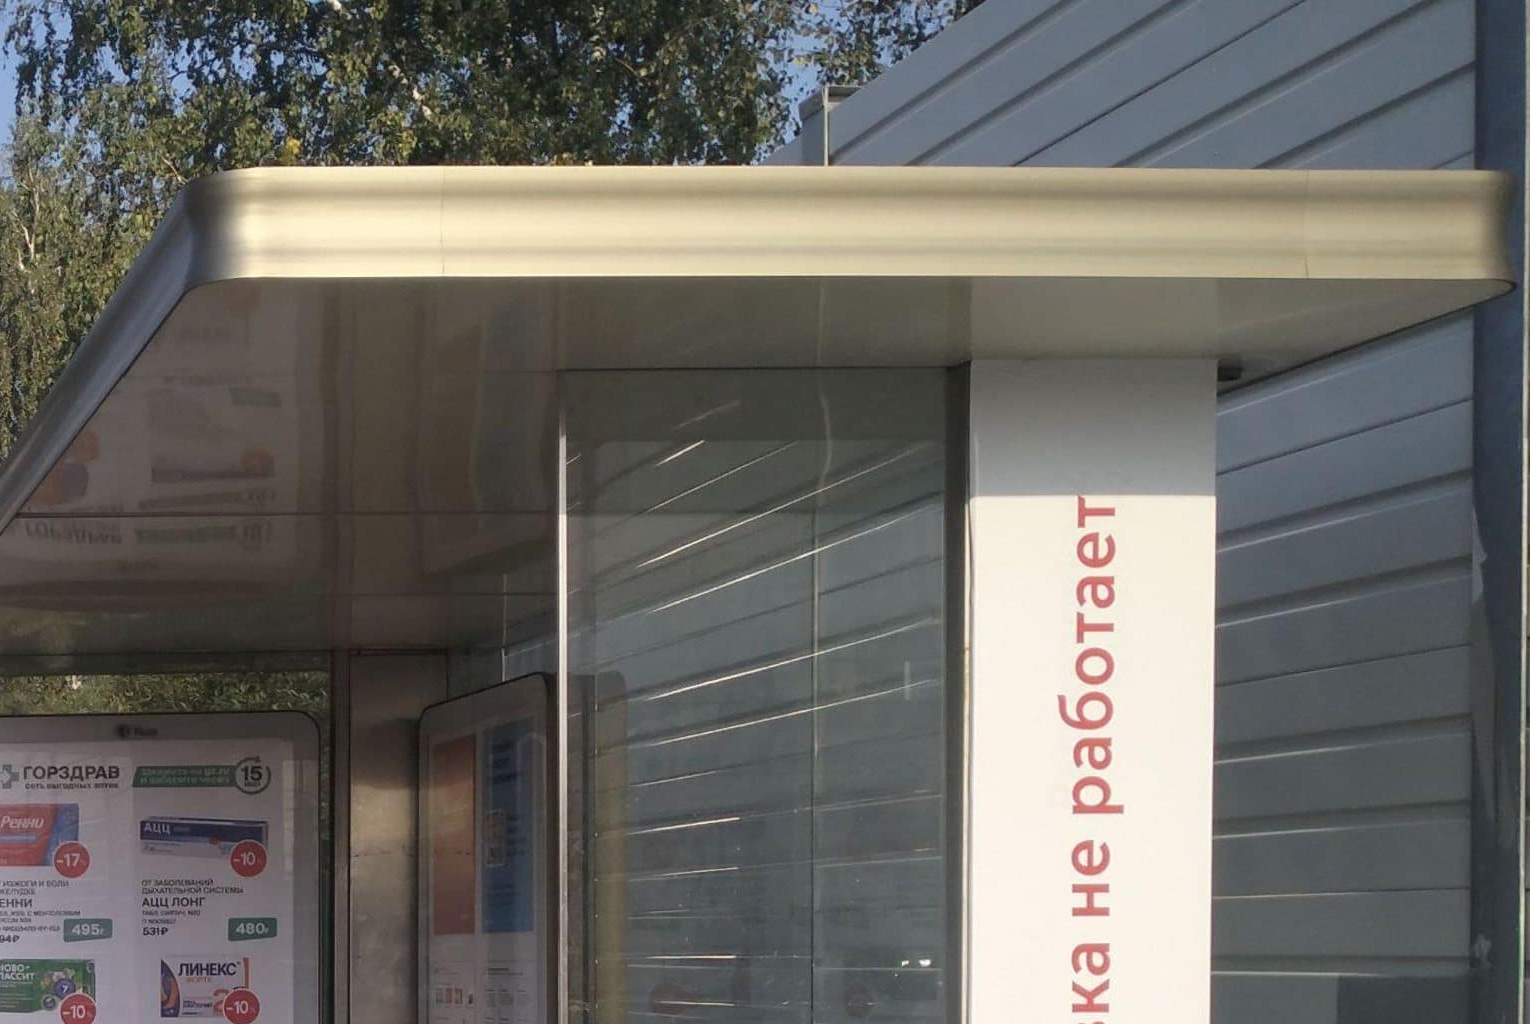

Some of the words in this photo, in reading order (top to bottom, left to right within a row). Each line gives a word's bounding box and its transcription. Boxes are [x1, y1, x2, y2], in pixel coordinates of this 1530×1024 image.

[1056, 495, 1125, 816] работает
[22, 765, 120, 781] ГОРЗДРАВ
[240, 765, 263, 781] 15
[1070, 839, 1112, 917] не
[141, 897, 169, 908] АЦЦ
[171, 897, 206, 907] ЛОНГ
[177, 962, 237, 977] ЛИНЕКС
